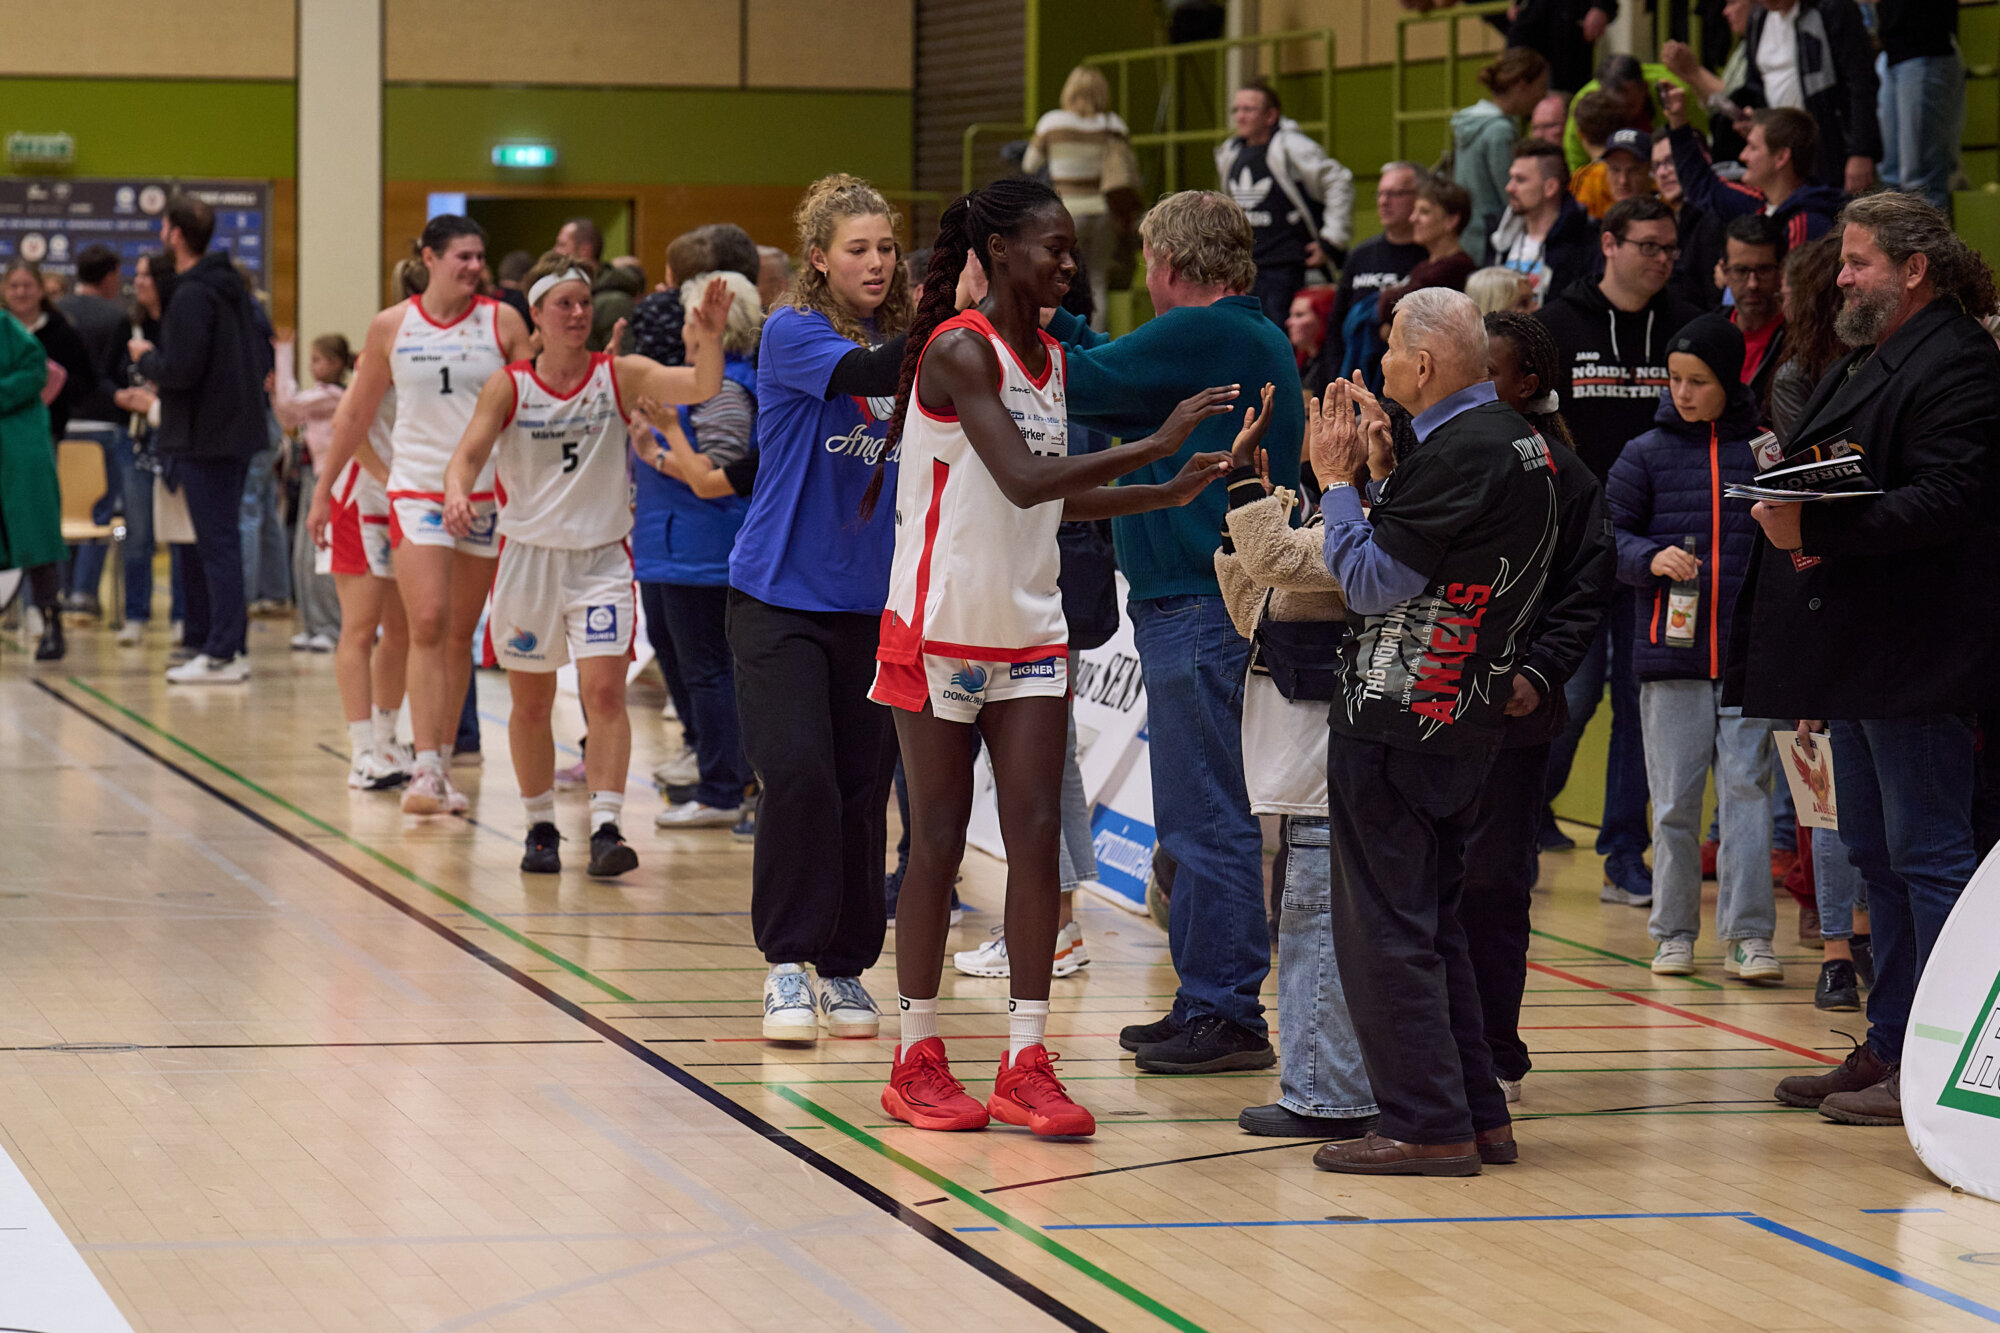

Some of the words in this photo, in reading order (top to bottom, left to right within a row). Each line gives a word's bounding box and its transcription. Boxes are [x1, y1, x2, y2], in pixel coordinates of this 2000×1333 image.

[438, 366, 453, 394] 1
[1020, 427, 1045, 441] ärker
[562, 442, 579, 473] 5
[1010, 665, 1054, 677] EIGNER
[1363, 669, 1386, 700] THG
[1401, 675, 1416, 706] DAMEN
